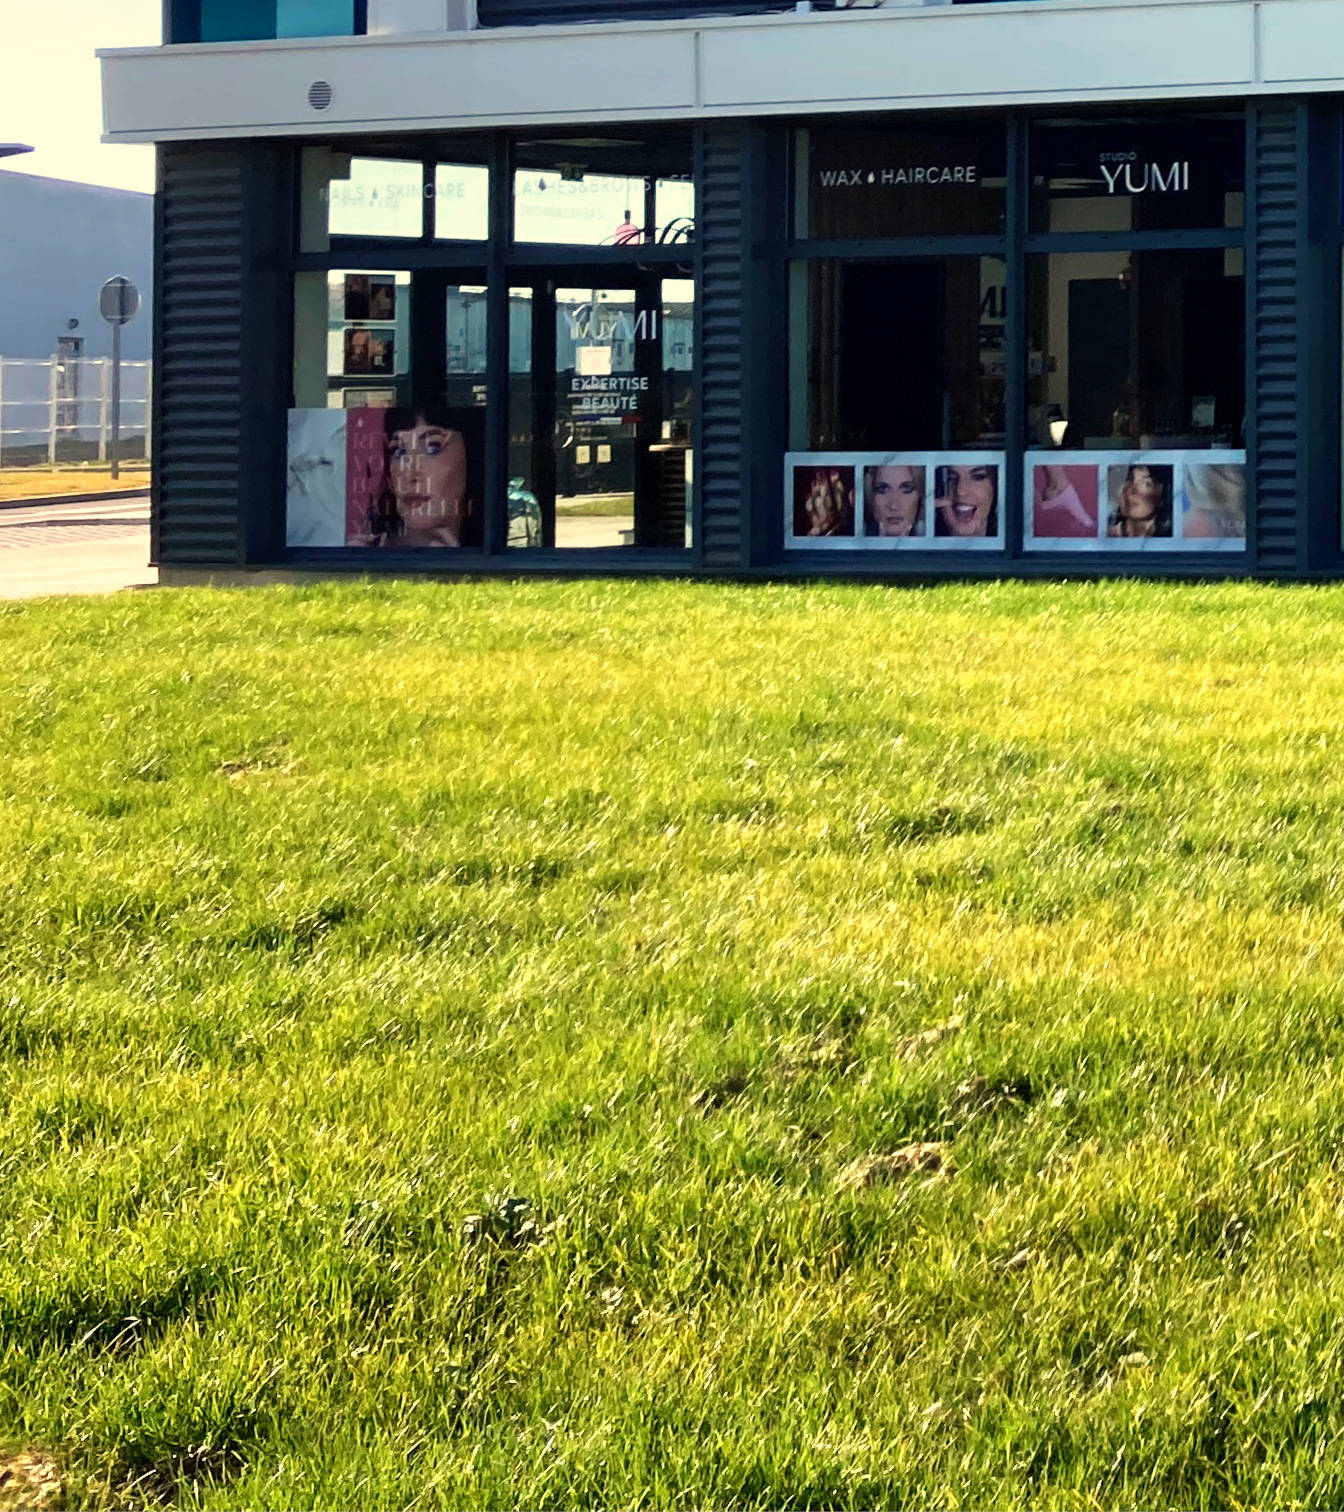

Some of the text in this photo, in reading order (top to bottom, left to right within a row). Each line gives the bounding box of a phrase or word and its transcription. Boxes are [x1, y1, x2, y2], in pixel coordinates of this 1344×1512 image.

[820, 166, 976, 187] WAX HAIRCARE
[1100, 161, 1188, 193] YUMI
[386, 183, 464, 199] SKINCARE
[572, 377, 648, 390] EXPERTISE
